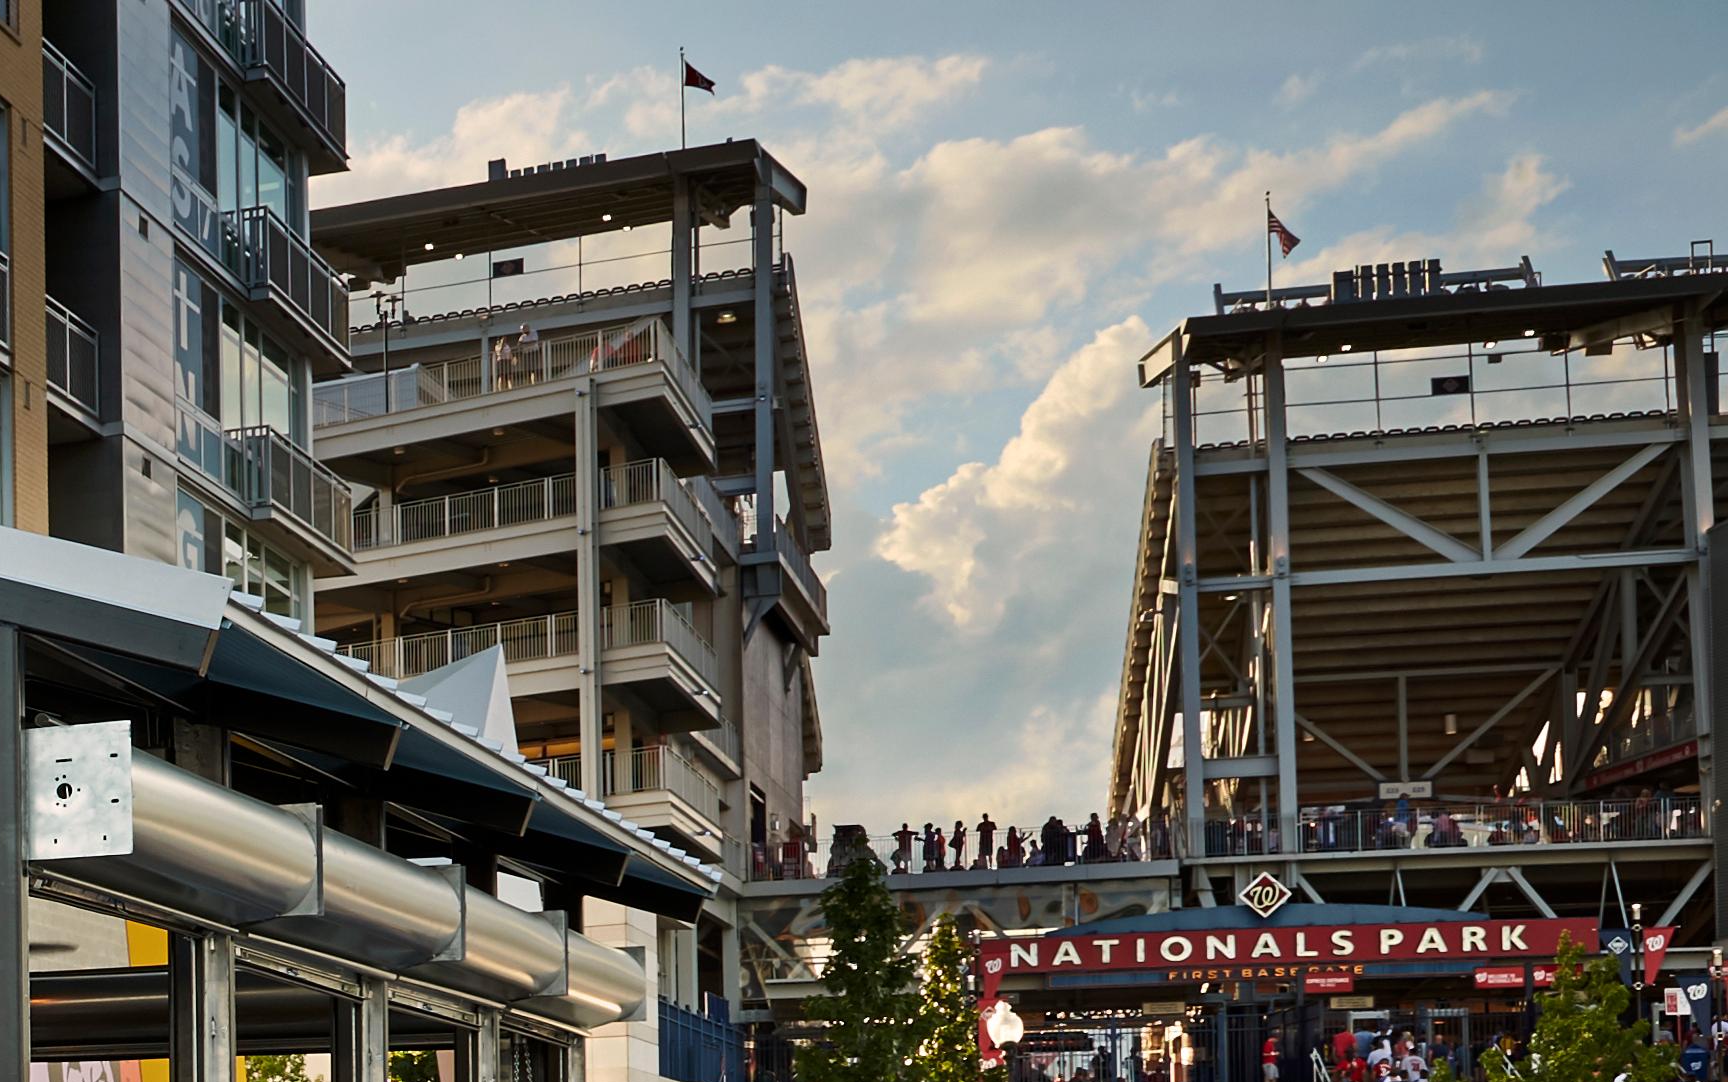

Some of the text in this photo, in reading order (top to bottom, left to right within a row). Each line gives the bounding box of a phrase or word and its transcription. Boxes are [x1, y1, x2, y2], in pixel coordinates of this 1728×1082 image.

[1009, 925, 1529, 968] NATIONALS PARK
[1168, 969, 1232, 981] FIRST
[1241, 967, 1297, 978] BASE
